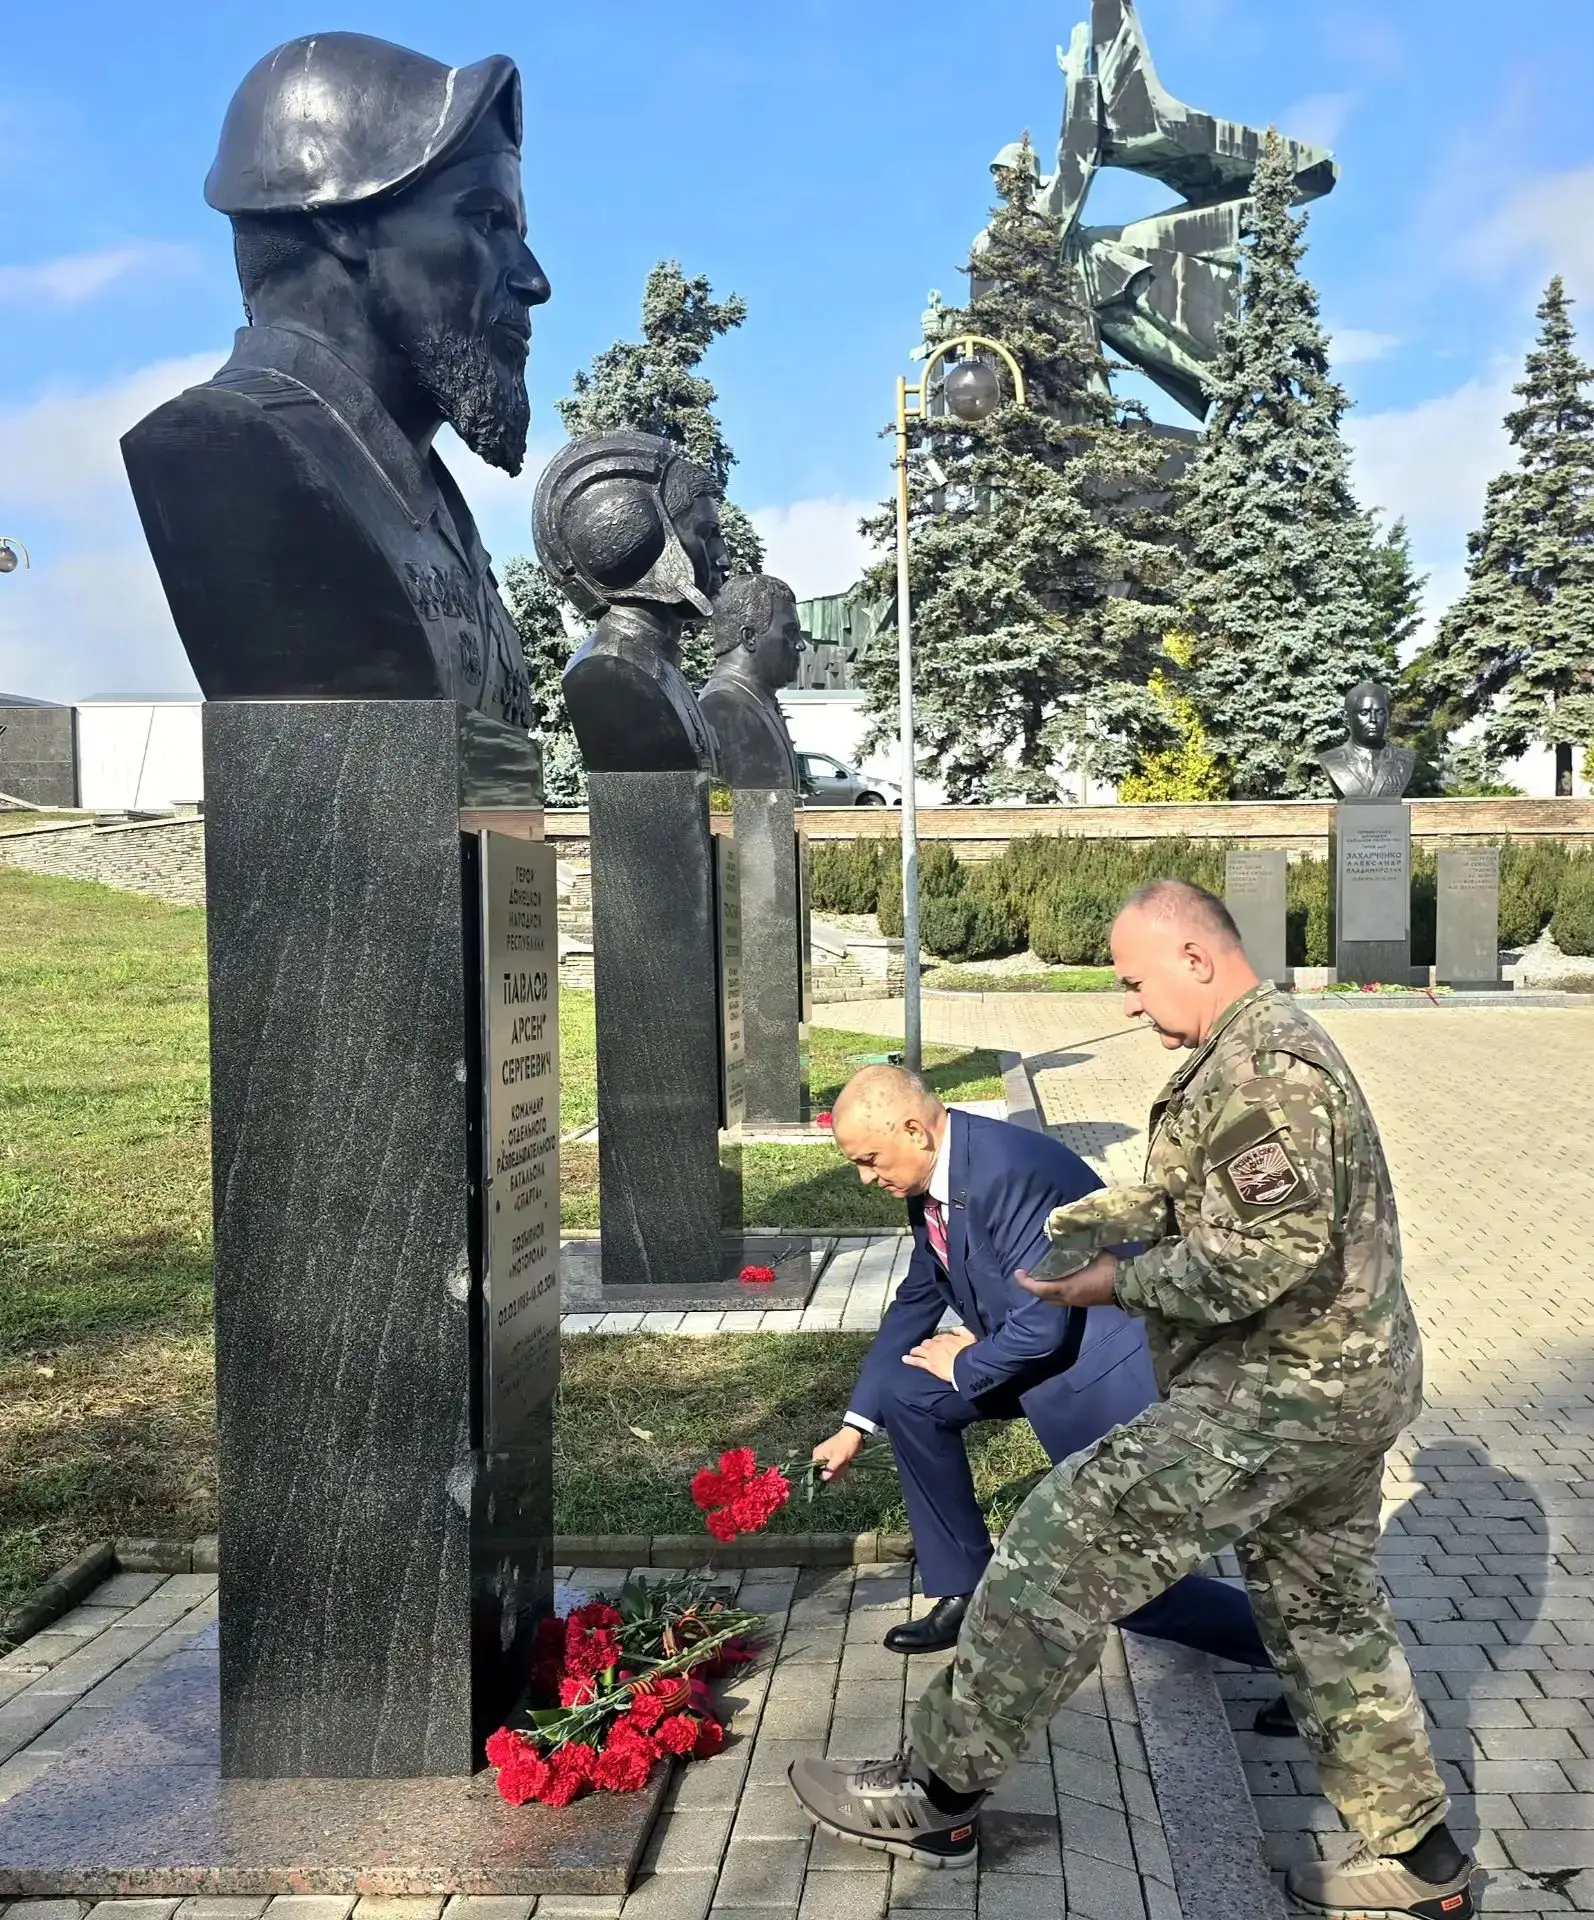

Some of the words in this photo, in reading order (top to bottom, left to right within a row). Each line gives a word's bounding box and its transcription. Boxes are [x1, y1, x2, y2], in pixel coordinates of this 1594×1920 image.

[503, 971, 548, 1005] ПАВЛОВ
[511, 1015, 543, 1045] АРСЕН
[502, 1051, 552, 1086] СЕРГЕЕВИЧ
[511, 1096, 544, 1121] КОМАНДИР
[508, 1117, 547, 1146] ОТДЕЛЬНОГО
